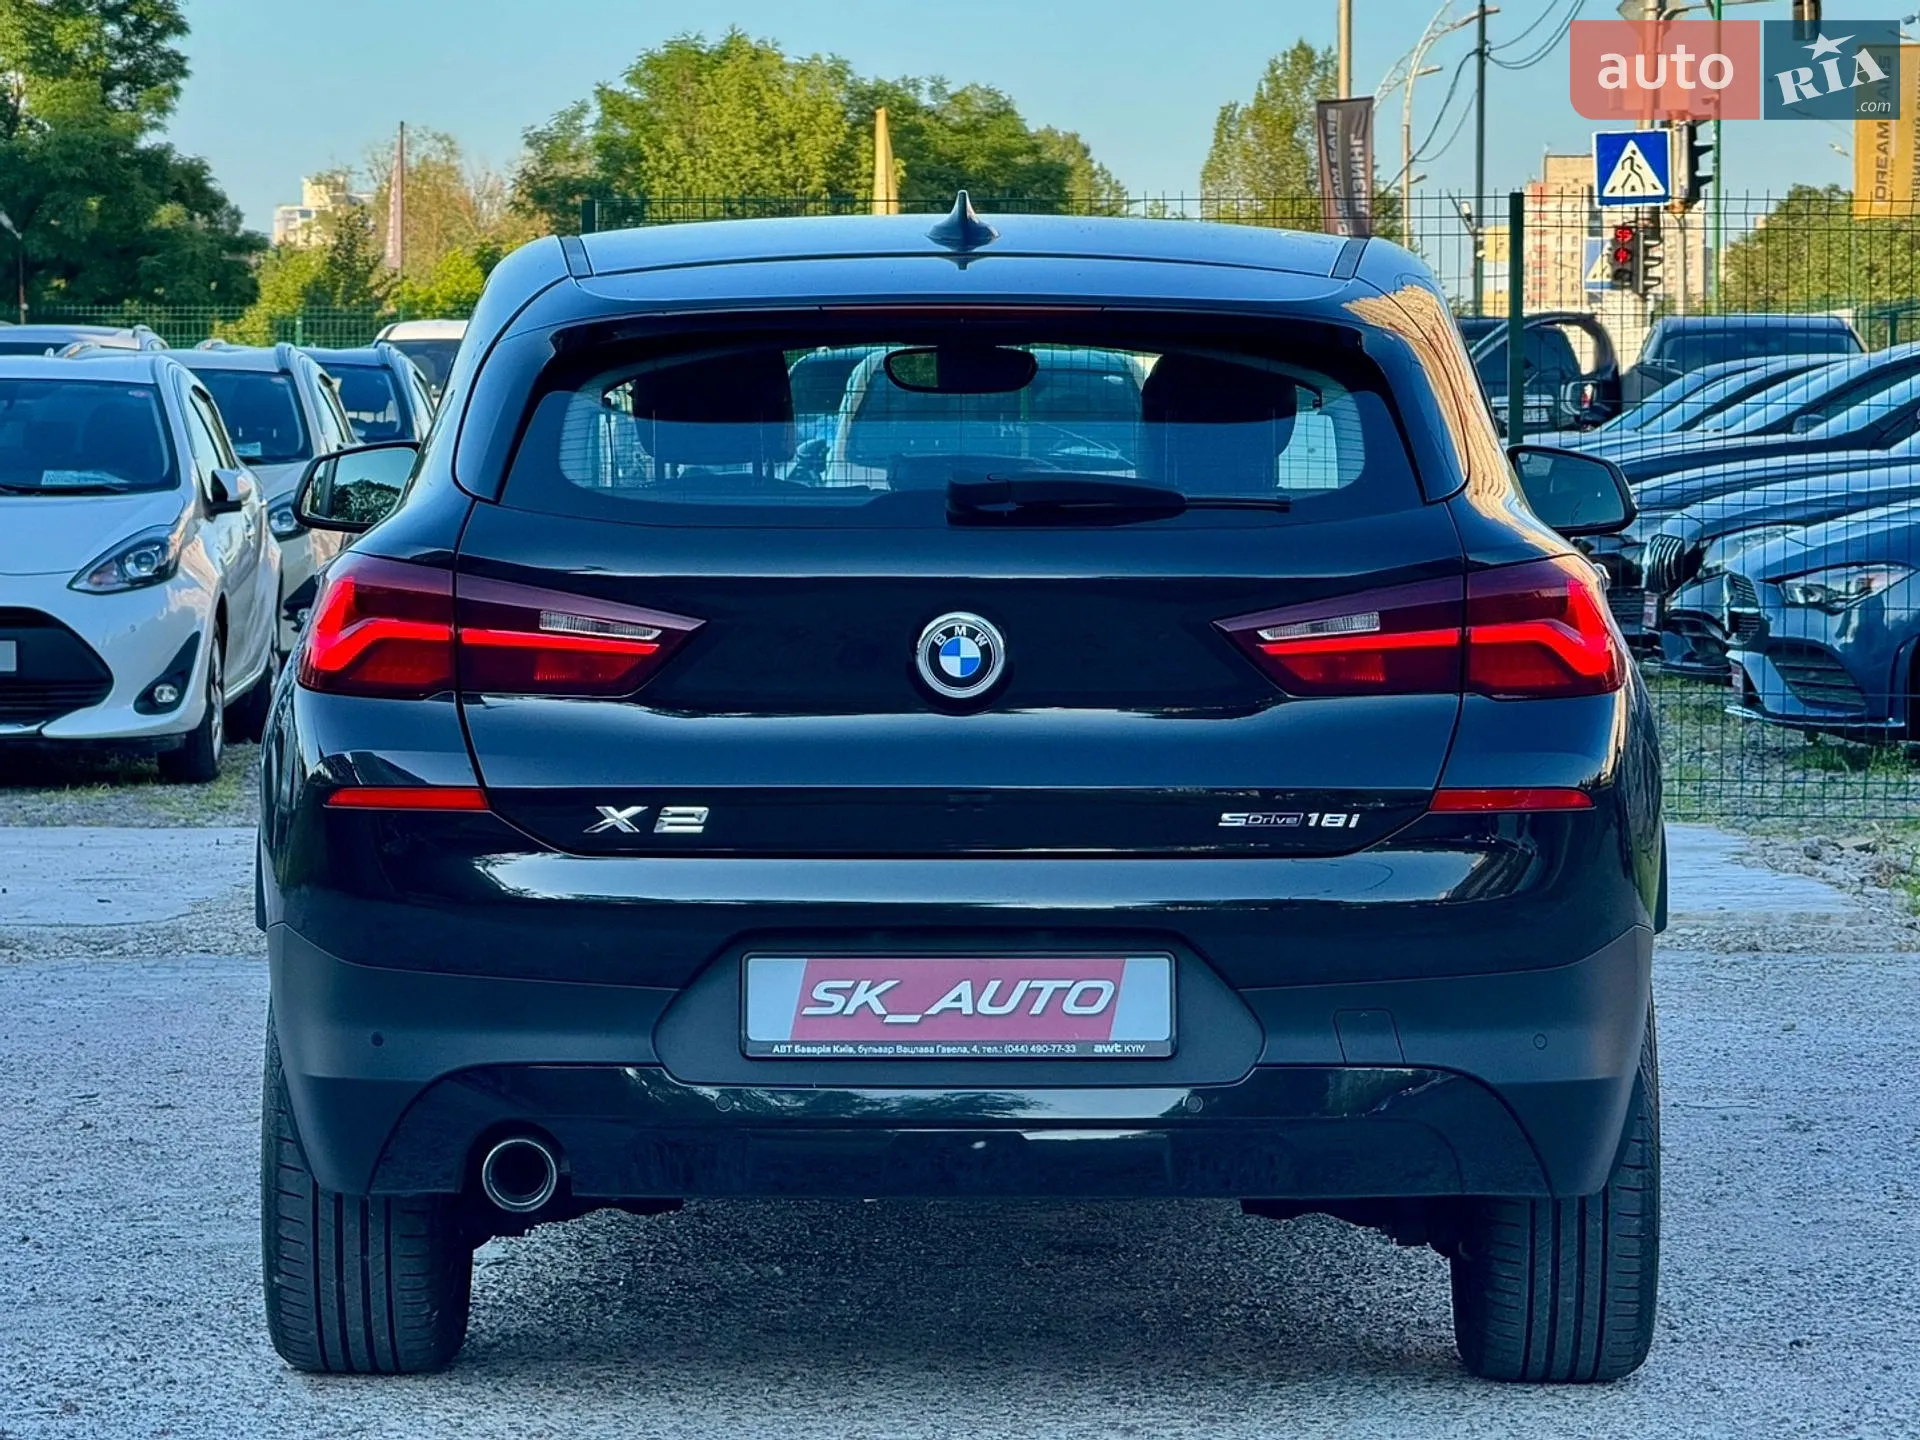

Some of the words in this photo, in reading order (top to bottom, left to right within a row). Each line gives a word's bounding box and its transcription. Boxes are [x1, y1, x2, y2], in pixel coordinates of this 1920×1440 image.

[1874, 119, 1890, 201] DREAM
[933, 626, 988, 648] BMW
[801, 980, 1115, 1023] SK_AUTO
[772, 1044, 793, 1054] АВТ
[794, 1044, 832, 1055] Баварія
[857, 1044, 894, 1055] бульвар
[896, 1044, 935, 1055] Вацлава
[936, 1044, 970, 1055] Гавела,
[971, 1044, 980, 1055] 4,
[982, 1044, 1003, 1054] тел.:
[1004, 1044, 1029, 1055] (044)
[1030, 1044, 1077, 1054] 490-77-33
[1093, 1044, 1123, 1054] awt
[1124, 1044, 1146, 1054] KYIV
